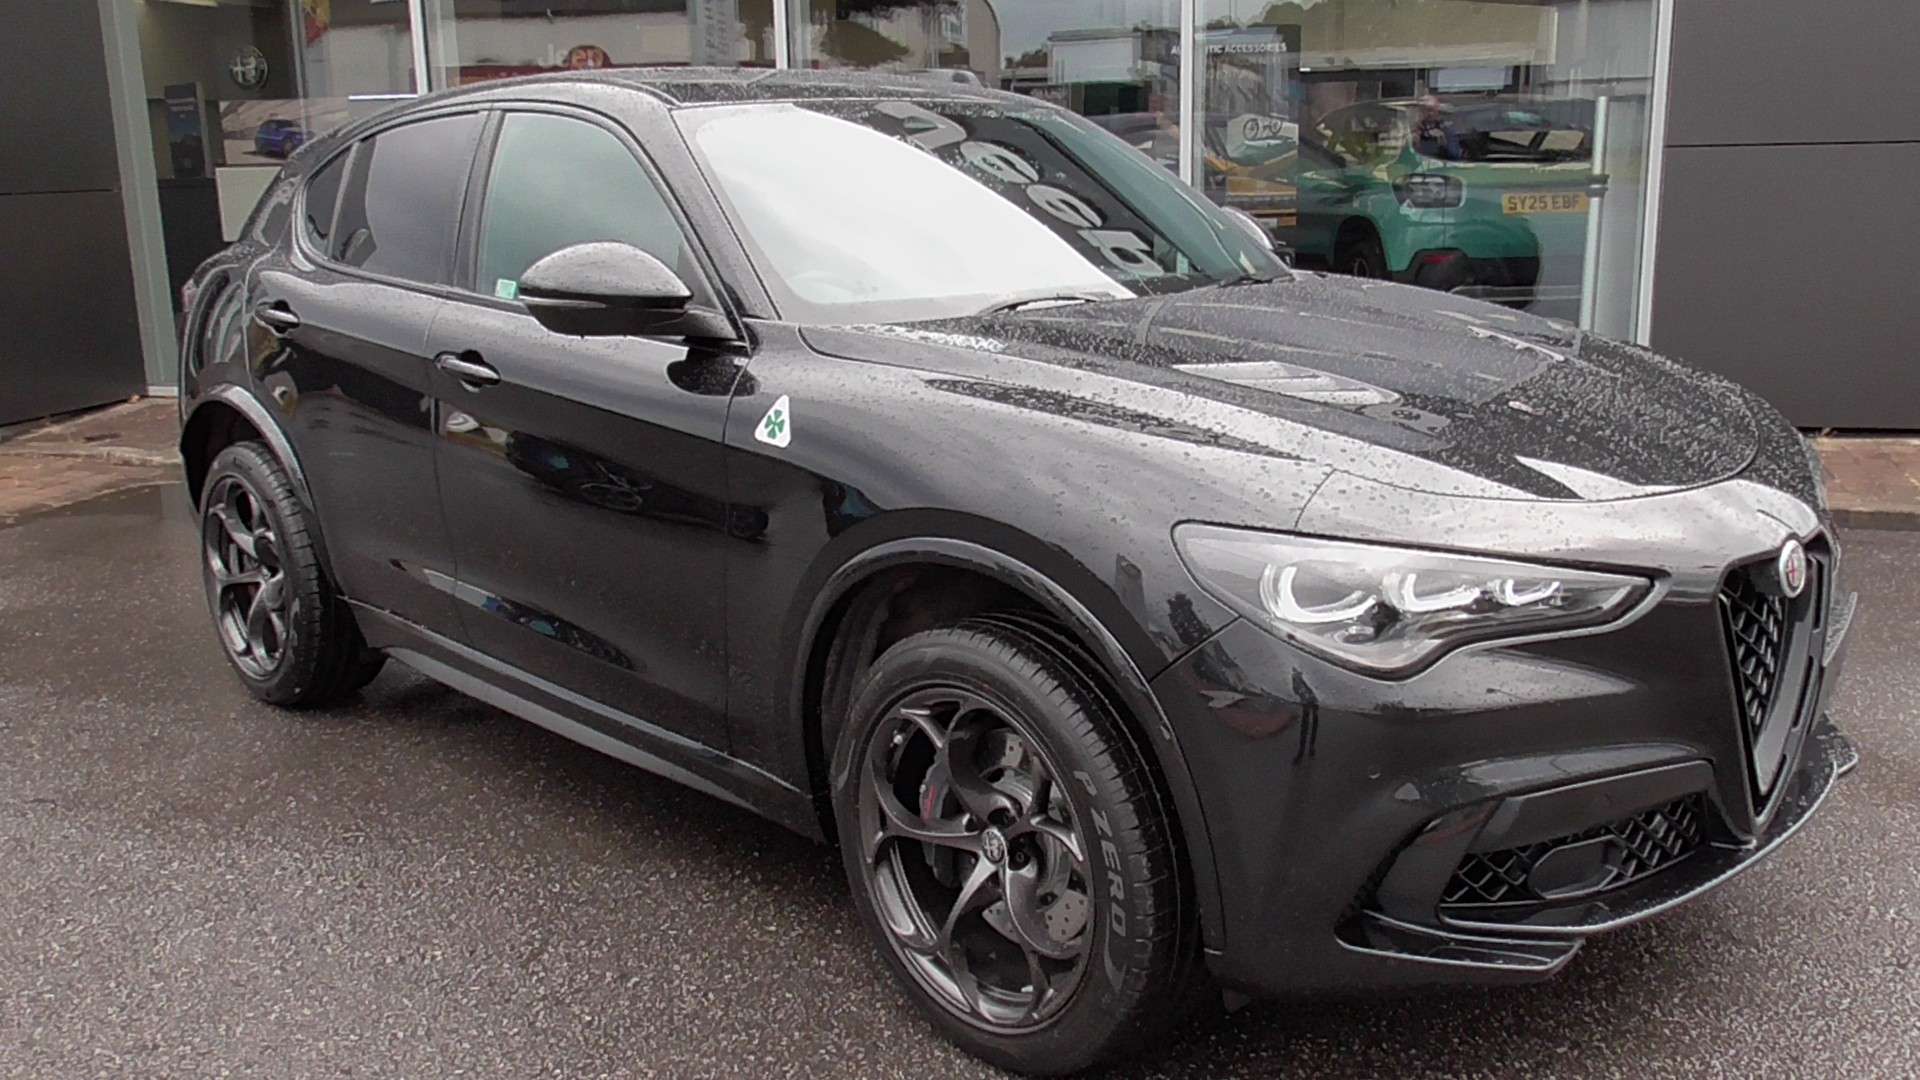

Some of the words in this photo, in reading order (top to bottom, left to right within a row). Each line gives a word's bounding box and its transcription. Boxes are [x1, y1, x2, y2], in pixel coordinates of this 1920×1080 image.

[1507, 196, 1548, 211] SY25
[1073, 770, 1098, 797] P
[1091, 807, 1126, 937] ZERO
